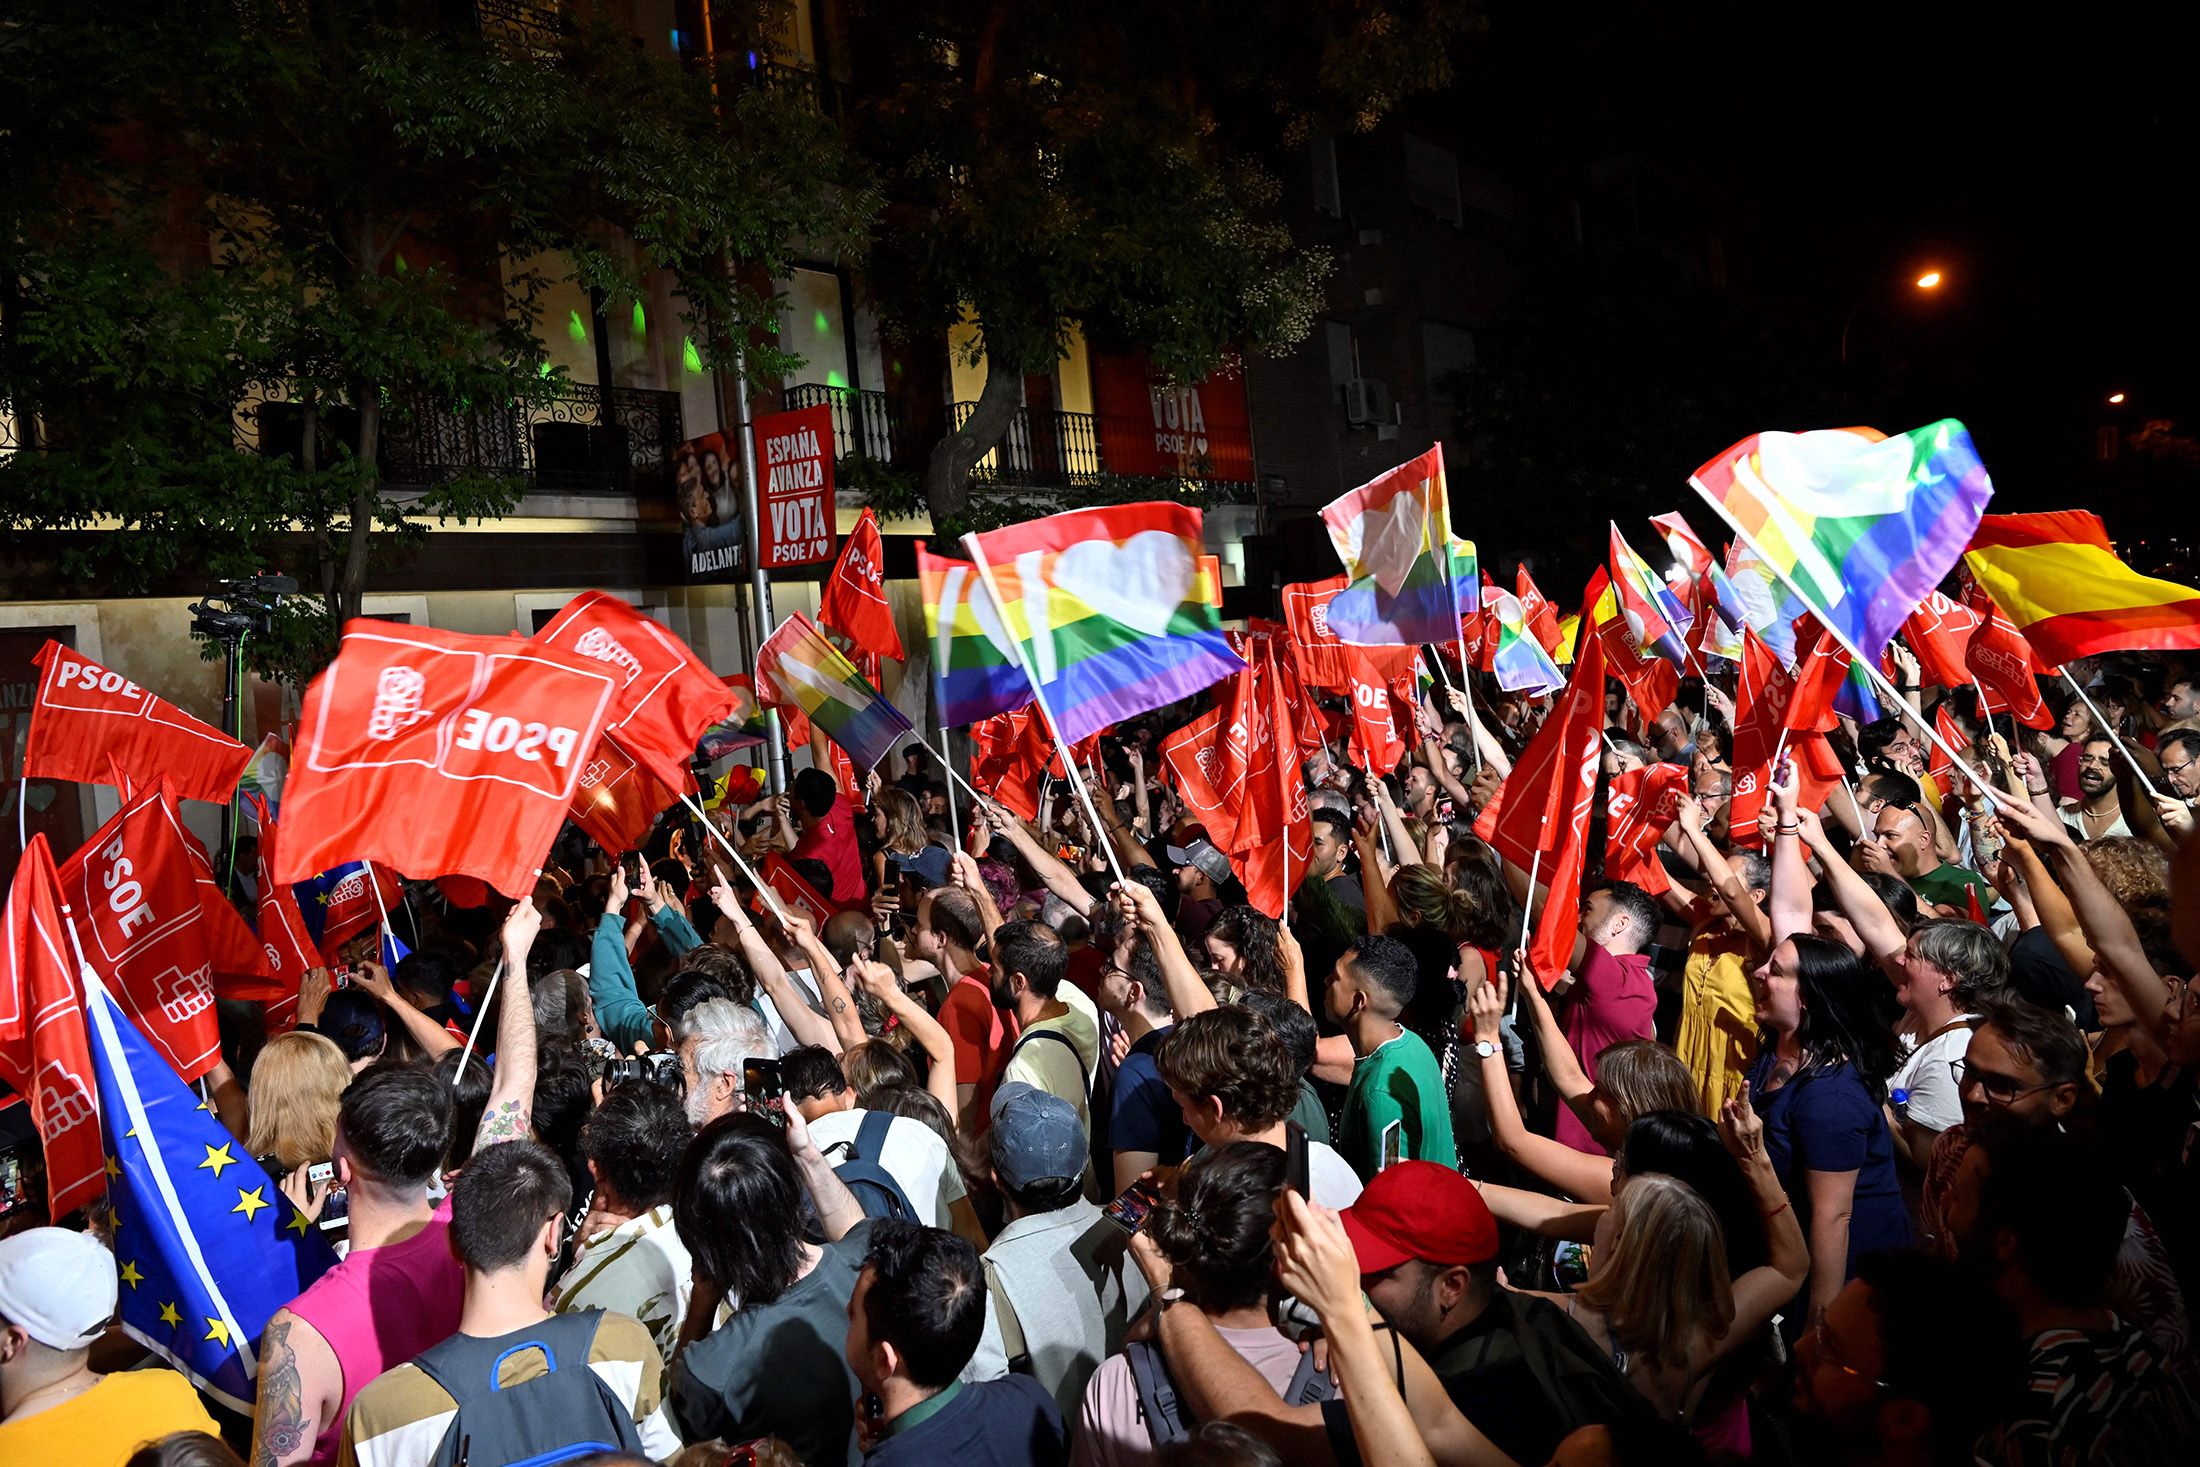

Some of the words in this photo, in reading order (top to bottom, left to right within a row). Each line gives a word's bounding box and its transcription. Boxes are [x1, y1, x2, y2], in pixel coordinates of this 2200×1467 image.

[1148, 383, 1206, 433] VOTA
[766, 426, 821, 464] ESPAÑA
[1155, 433, 1187, 455] PSOE
[769, 460, 823, 493] AVANZA
[770, 496, 827, 543] VOTA
[773, 543, 806, 562] PSOE
[57, 661, 142, 700] PSOE
[102, 833, 156, 939] PSOE
